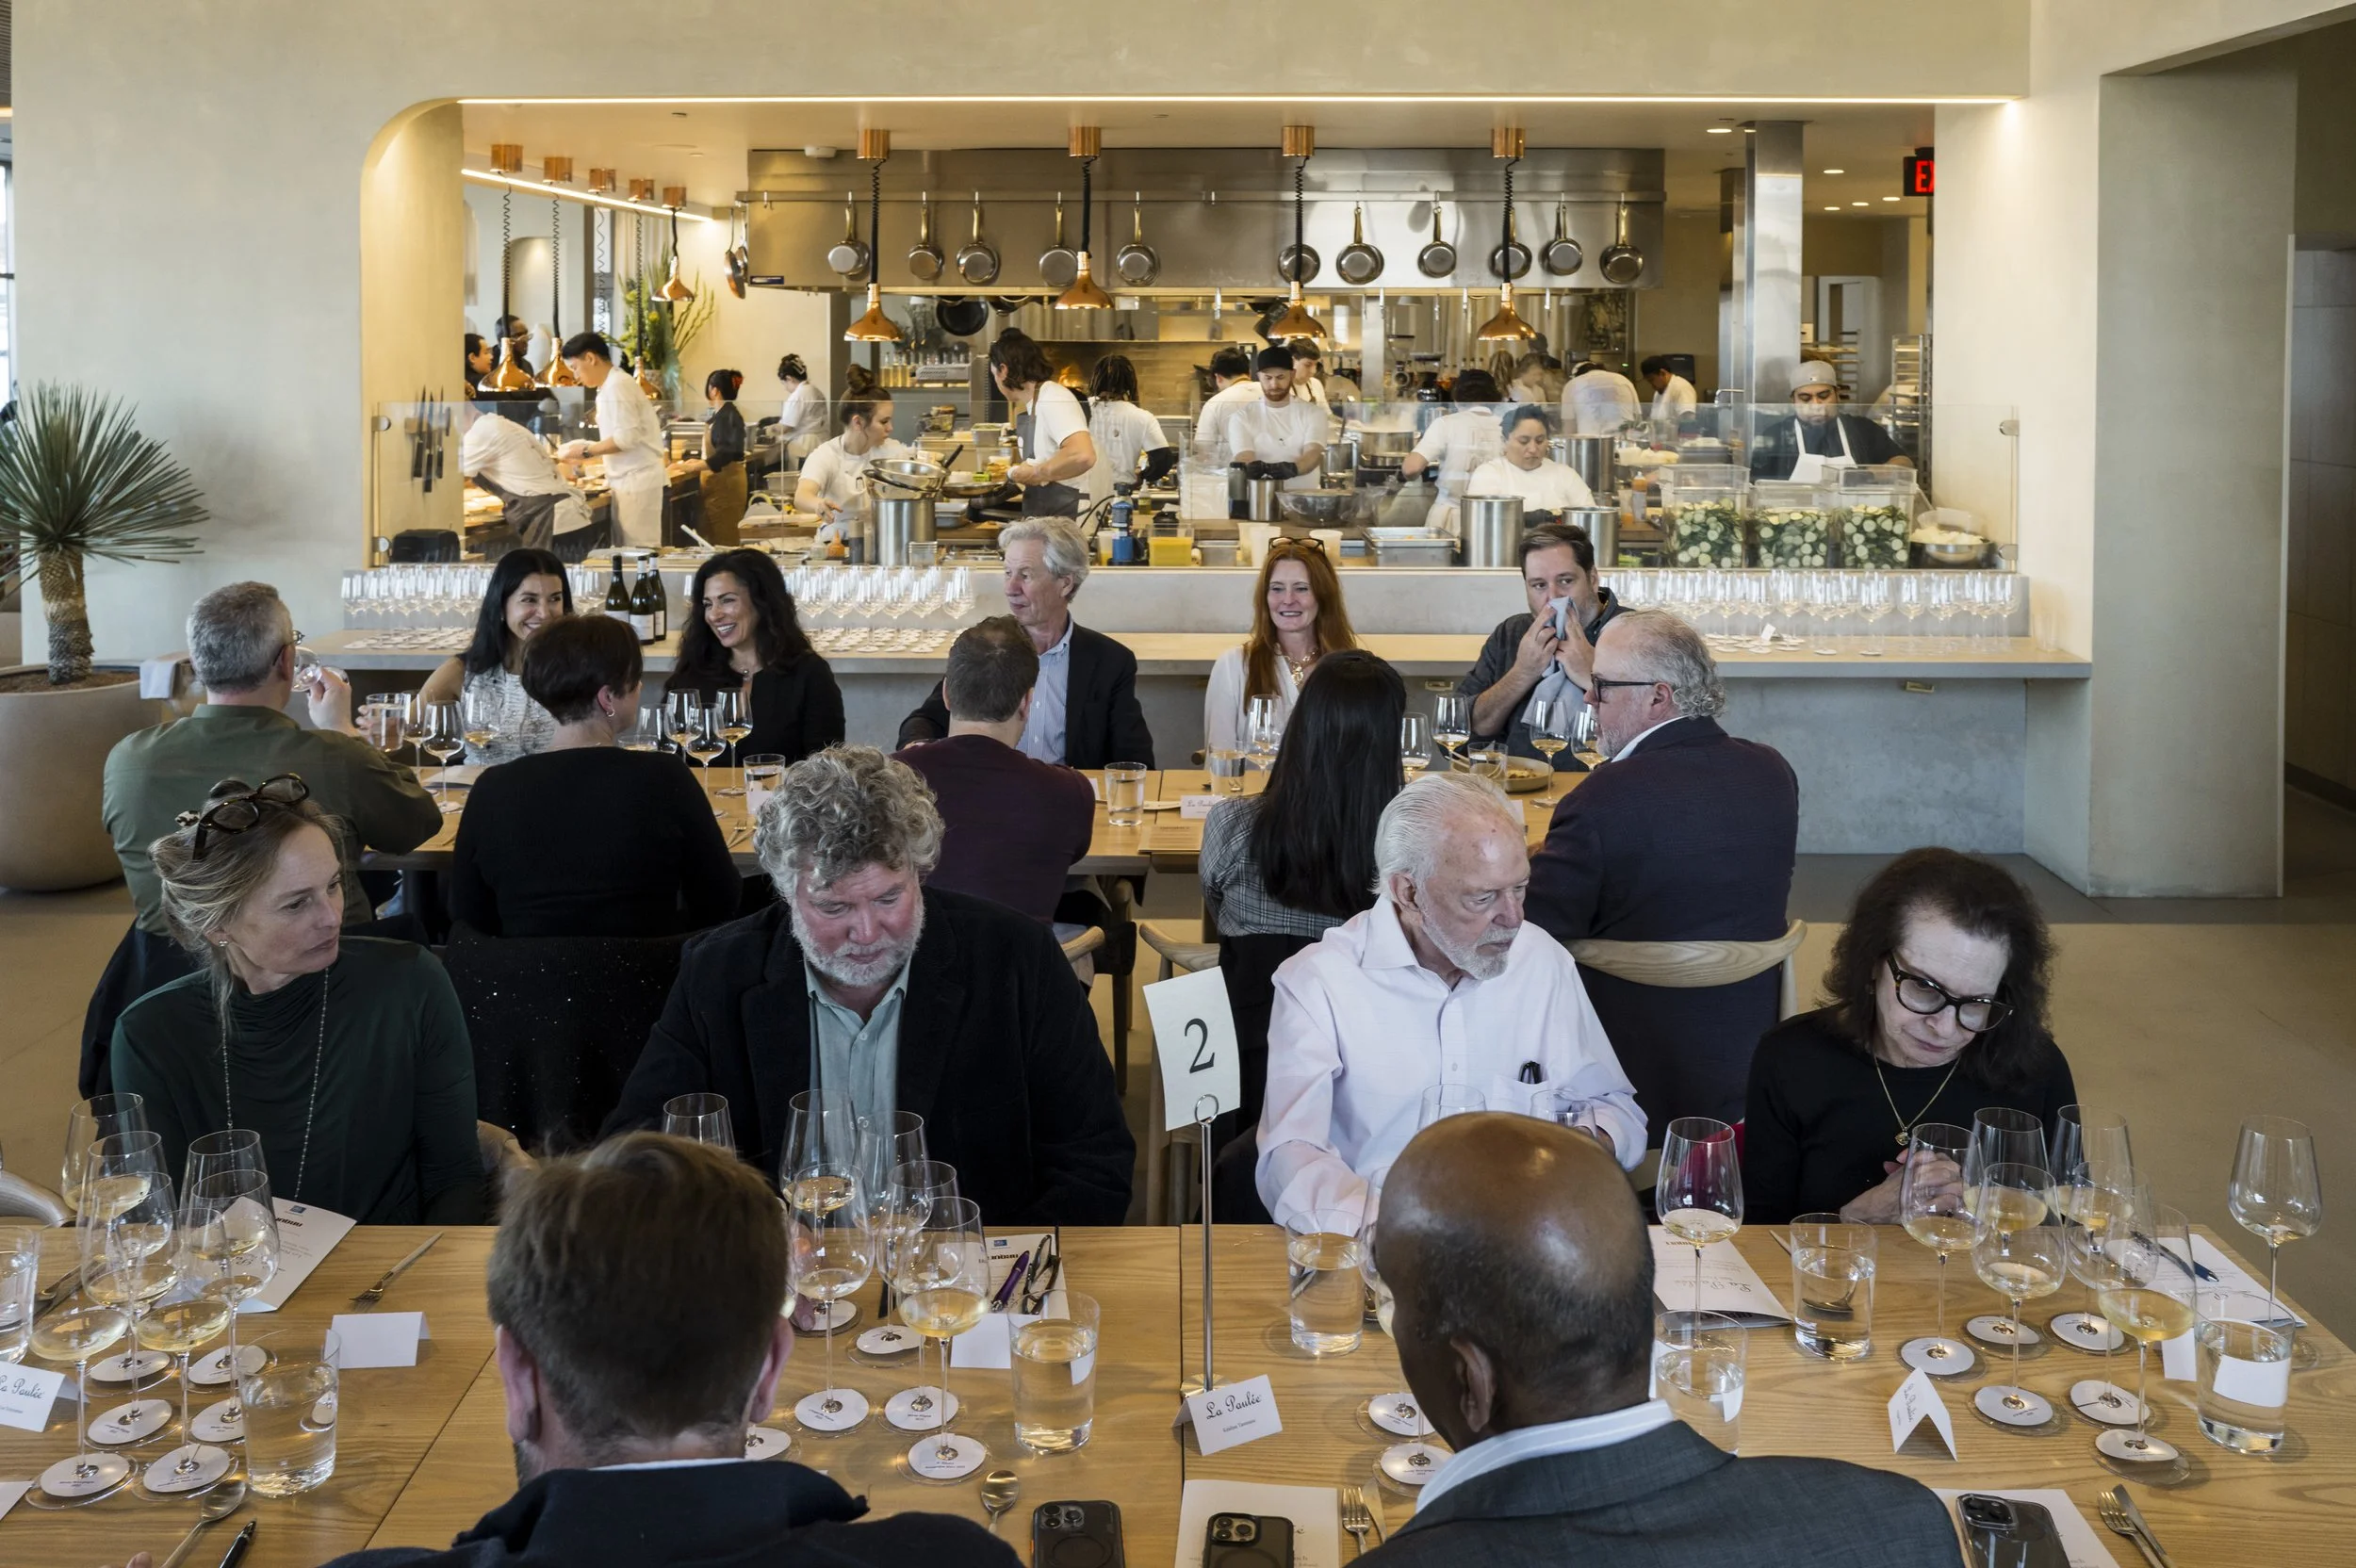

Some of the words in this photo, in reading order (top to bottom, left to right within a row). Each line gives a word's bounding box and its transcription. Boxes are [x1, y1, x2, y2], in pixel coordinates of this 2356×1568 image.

[1185, 1018, 1215, 1074] 2
[11, 1378, 43, 1399] Paulée
[1206, 1401, 1223, 1420] La
[1225, 1390, 1263, 1413] Paulée
